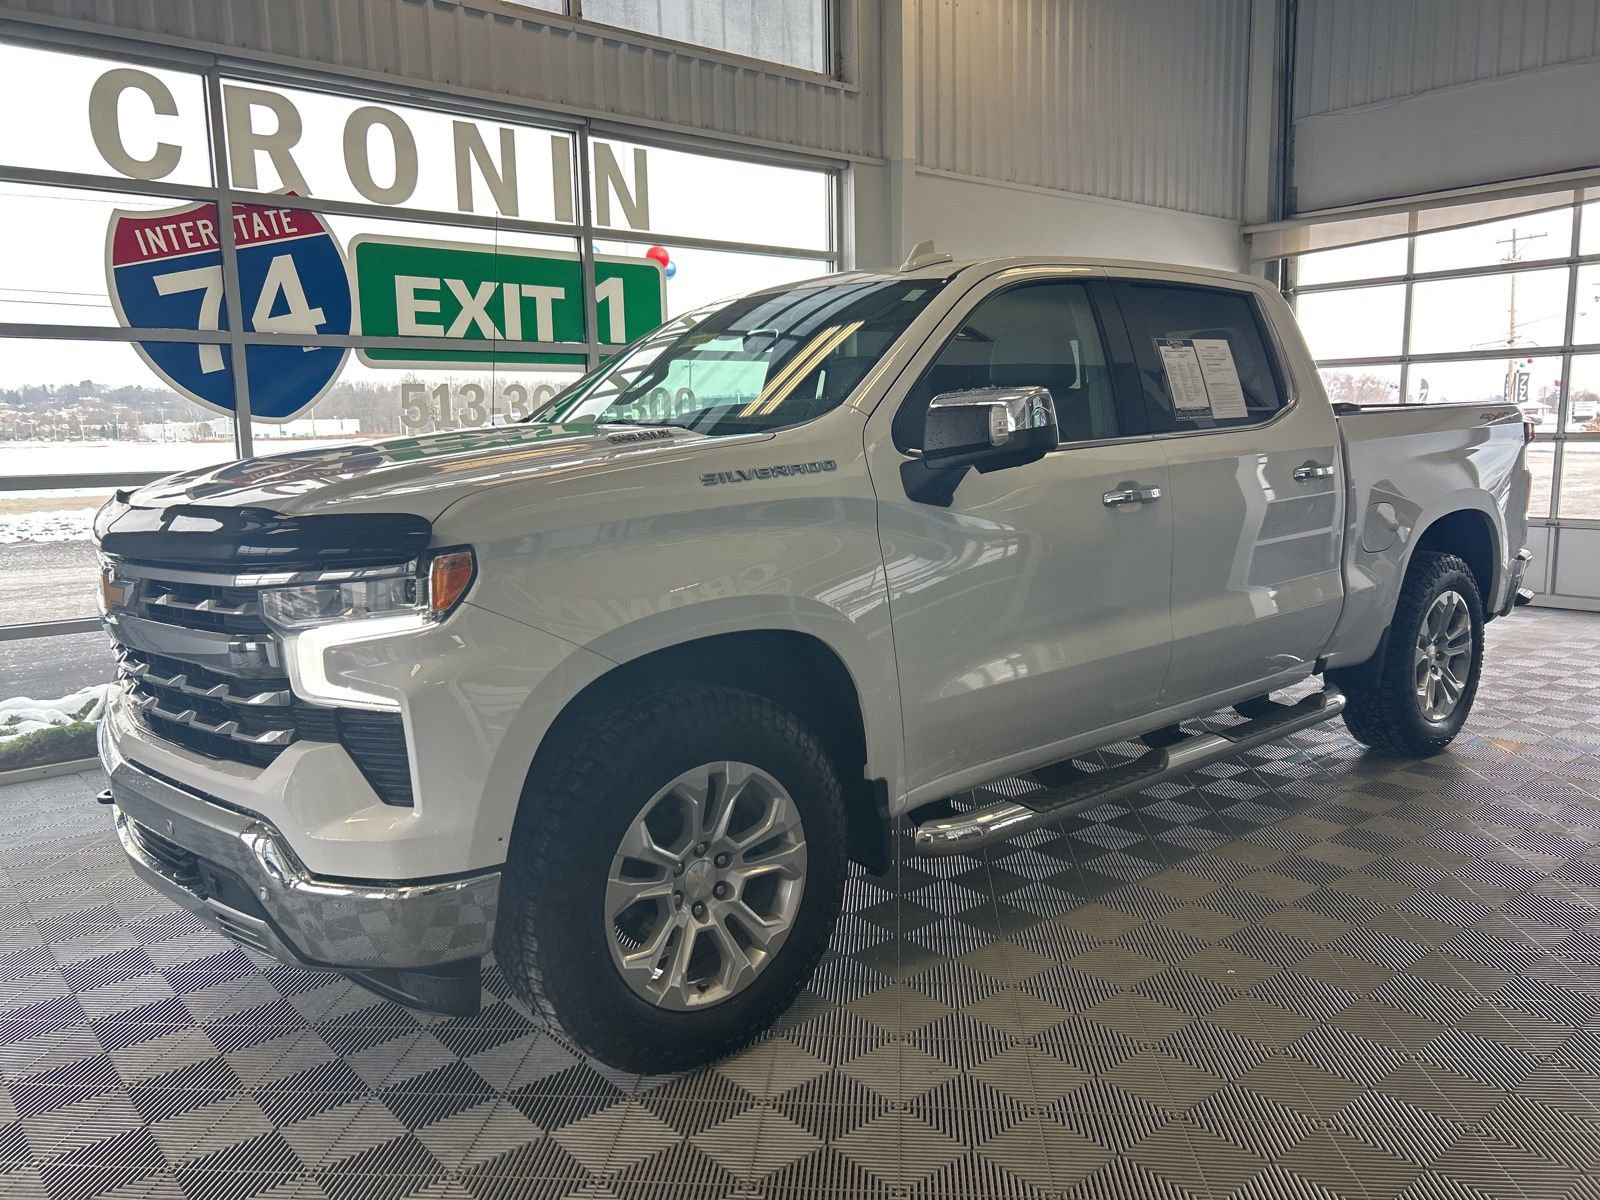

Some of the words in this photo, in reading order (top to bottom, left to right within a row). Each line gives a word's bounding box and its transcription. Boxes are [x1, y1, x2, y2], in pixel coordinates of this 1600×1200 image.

[89, 68, 649, 230] CRONIN
[134, 208, 298, 256] INTERTATE
[153, 254, 327, 374] 74
[394, 275, 564, 342] EXIT
[596, 277, 626, 343] 1
[700, 459, 838, 486] SILVERADO
